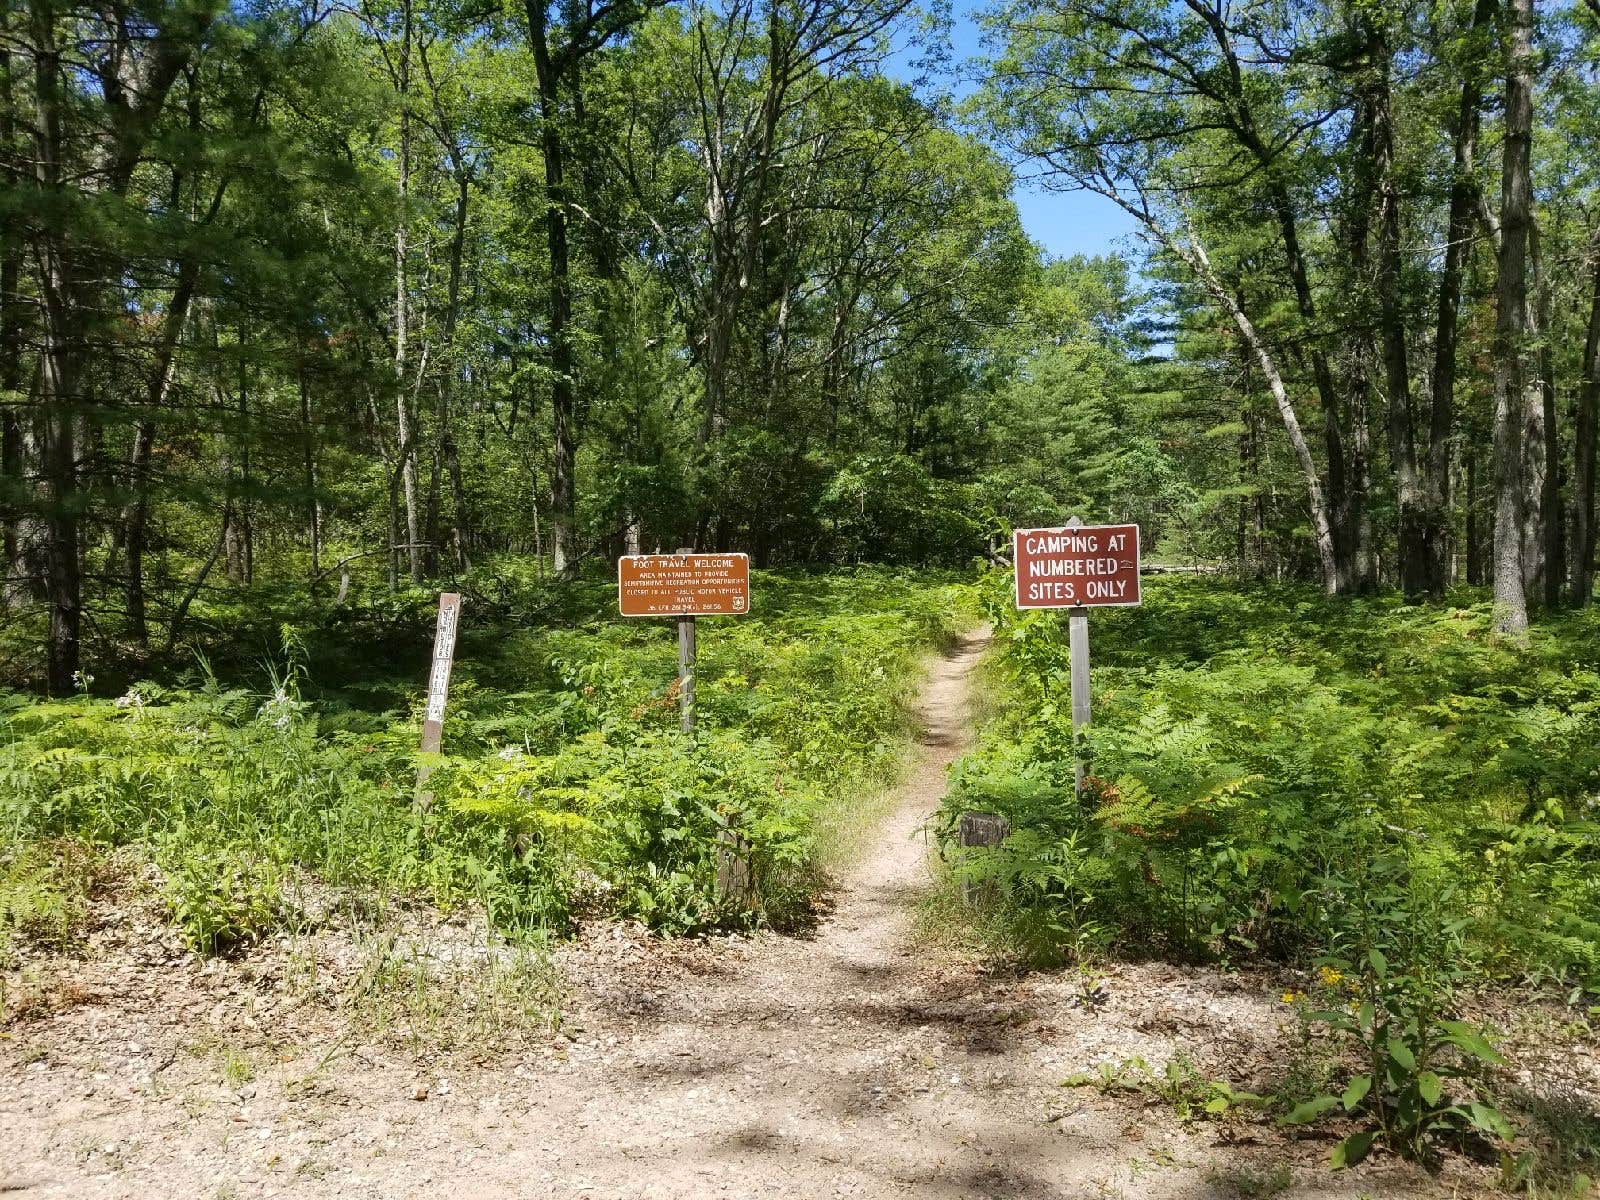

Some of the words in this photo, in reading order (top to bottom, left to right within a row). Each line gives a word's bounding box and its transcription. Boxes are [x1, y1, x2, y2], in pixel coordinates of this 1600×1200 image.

[1026, 535, 1098, 555] CAMPING
[1107, 534, 1126, 552] AT
[633, 560, 654, 569] FOOT
[659, 560, 691, 569] TRAVEL
[694, 559, 734, 568] WELCOME
[1029, 558, 1118, 578] NUMBERED
[1029, 581, 1075, 600] SITES
[1086, 580, 1127, 599] ONLY
